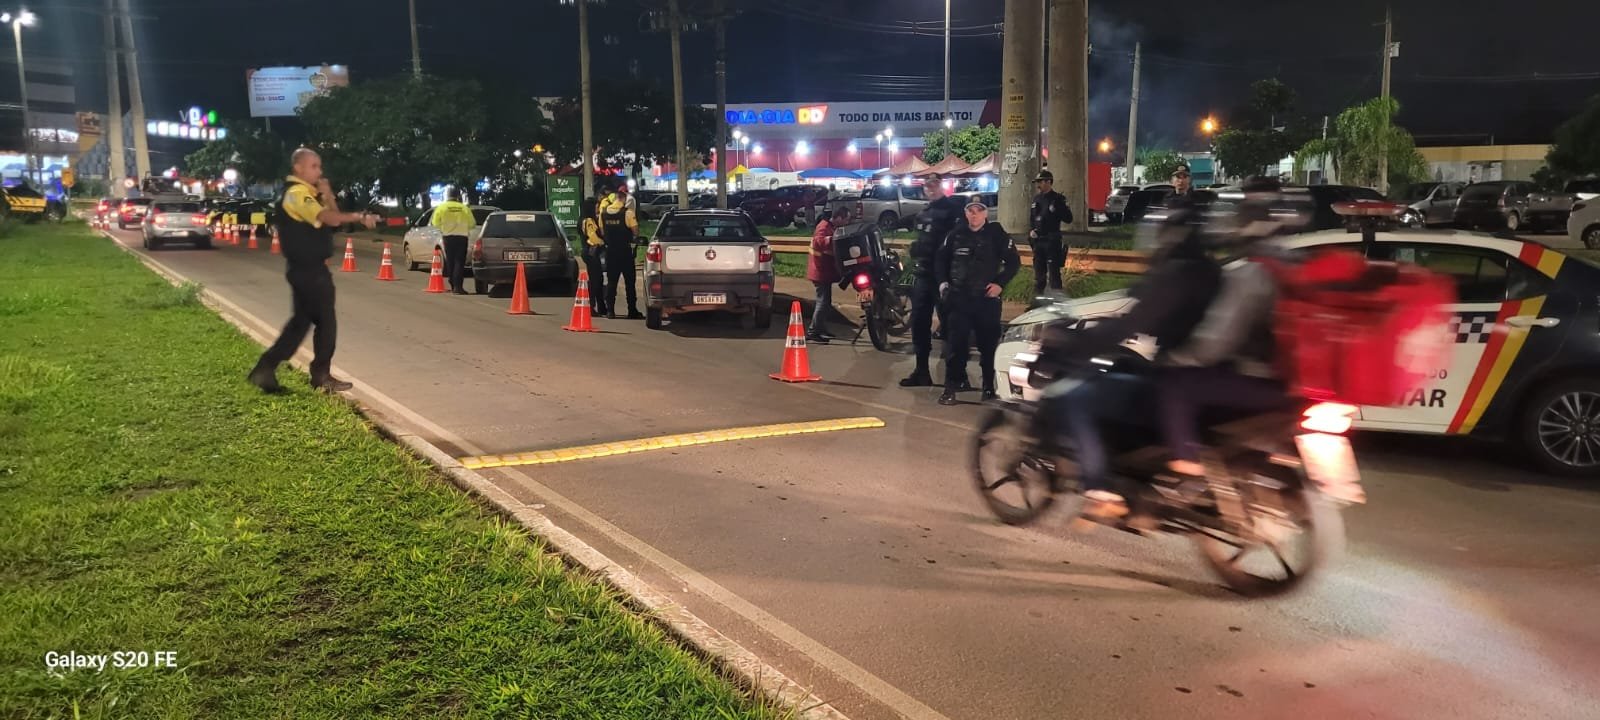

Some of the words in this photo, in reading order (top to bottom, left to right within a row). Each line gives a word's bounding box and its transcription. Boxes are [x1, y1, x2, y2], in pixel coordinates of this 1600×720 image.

[838, 113, 869, 123] TODO
[872, 112, 892, 122] DIA
[894, 112, 922, 122] MAIS
